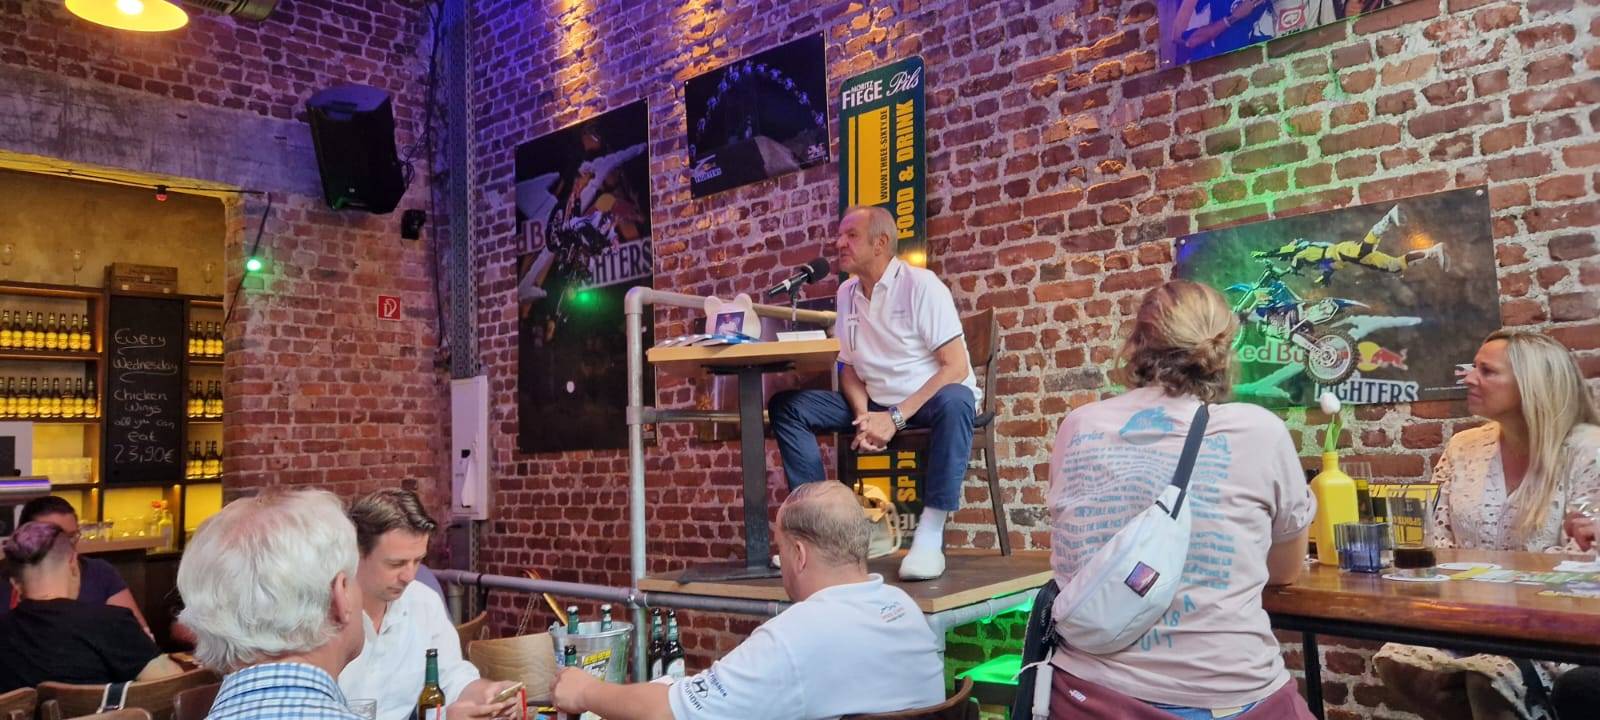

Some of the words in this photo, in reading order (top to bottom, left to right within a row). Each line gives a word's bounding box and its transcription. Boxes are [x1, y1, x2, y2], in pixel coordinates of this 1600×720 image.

[850, 80, 874, 93] MORITZ
[886, 66, 922, 97] Pils
[842, 80, 883, 110] FIEGE
[896, 99, 914, 163] DRINK
[899, 166, 914, 182] &
[897, 187, 915, 240] FOOD
[593, 241, 652, 284] HTERS
[114, 328, 167, 347] Every
[112, 357, 178, 374] Wednesday
[114, 389, 168, 401] Chicken
[113, 444, 175, 464] 23,90€
